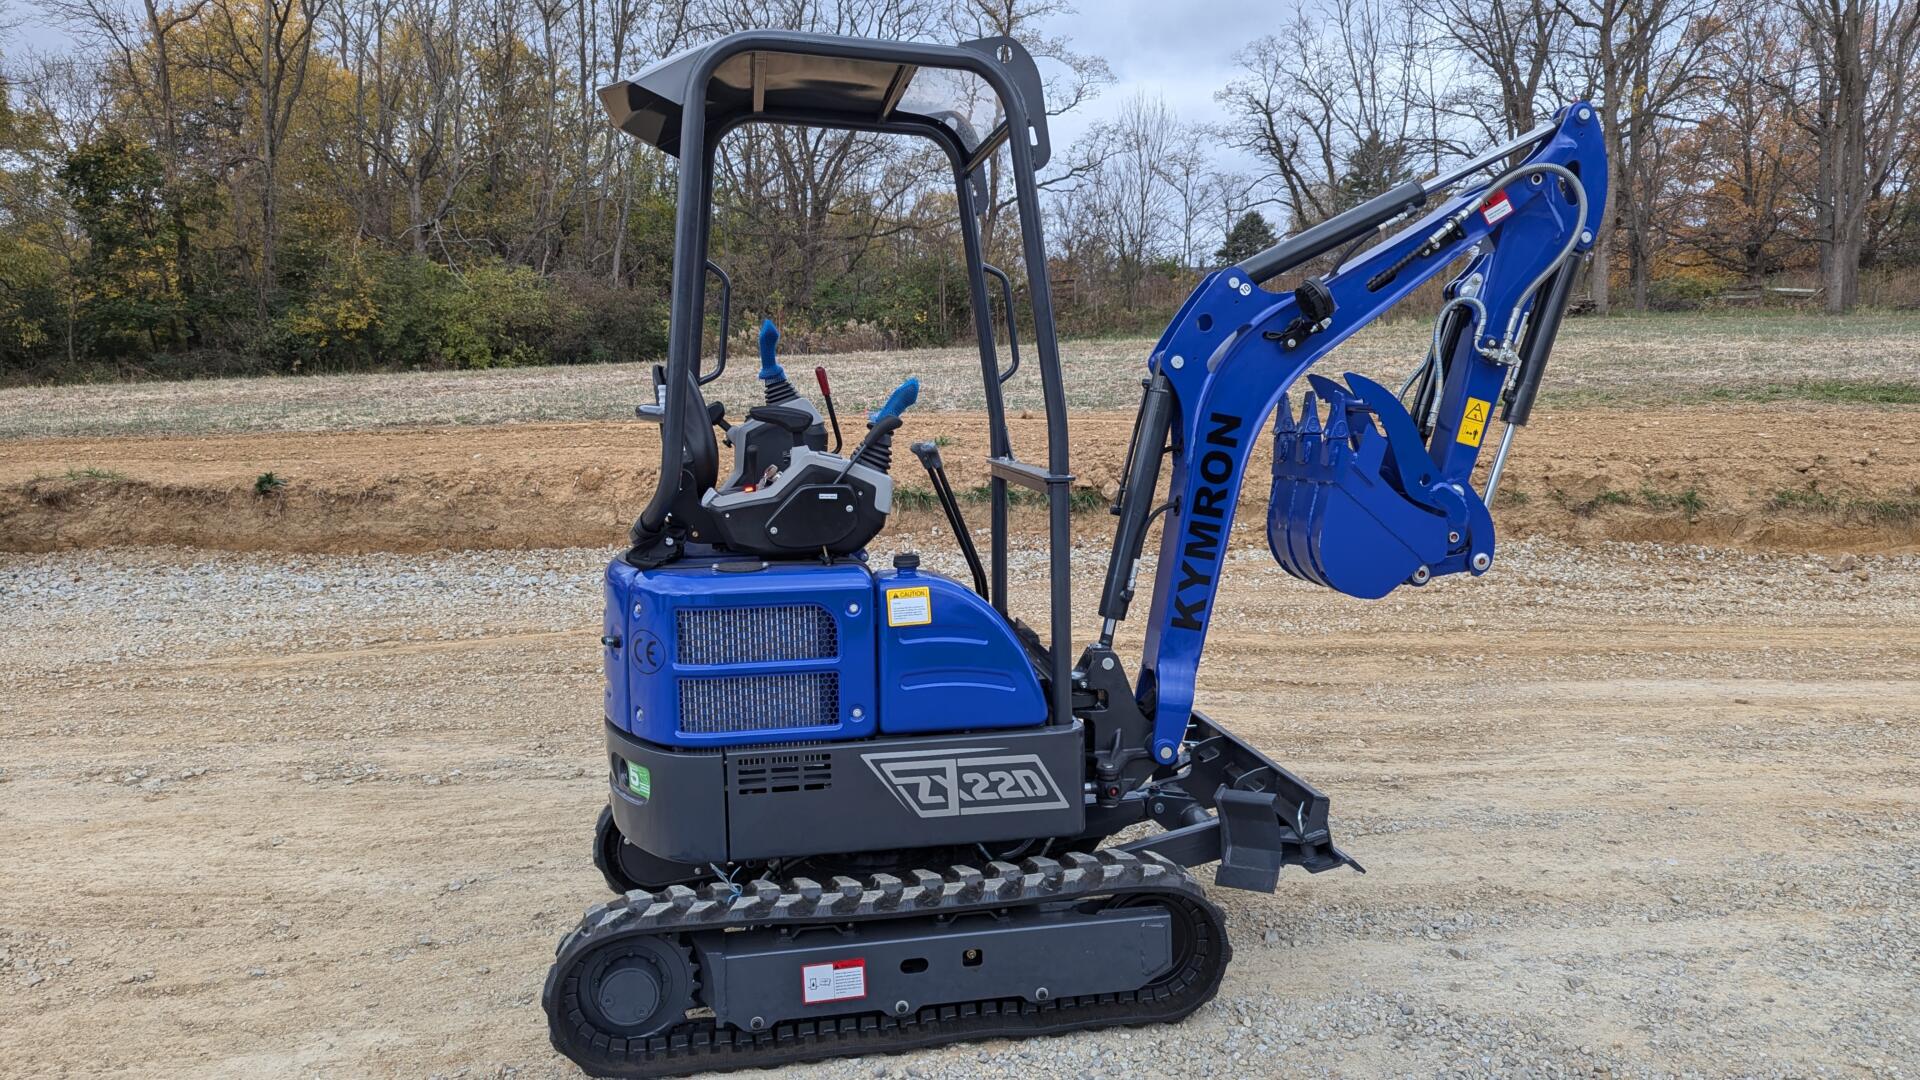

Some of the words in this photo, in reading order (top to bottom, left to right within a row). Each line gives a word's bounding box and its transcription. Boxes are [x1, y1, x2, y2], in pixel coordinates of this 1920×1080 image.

[1171, 412, 1242, 632] KYMRON
[900, 590, 926, 598] CAUTION
[634, 638, 657, 667] CE
